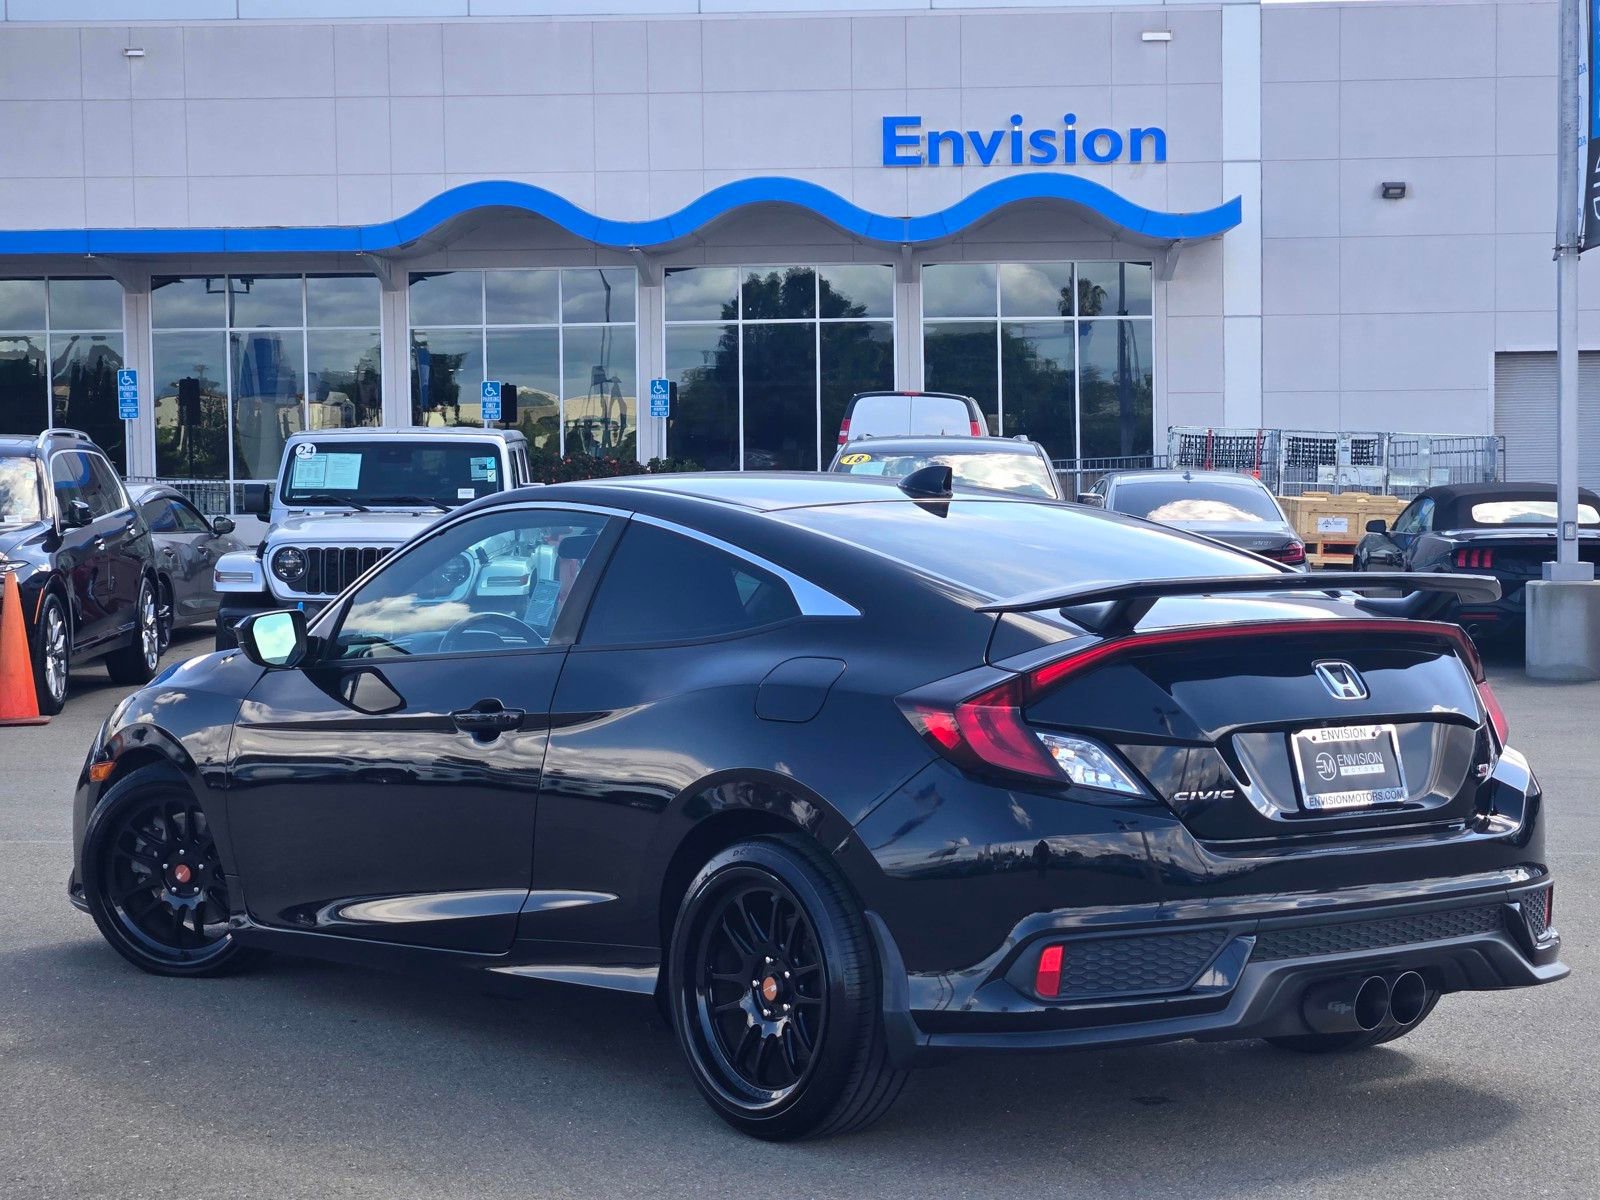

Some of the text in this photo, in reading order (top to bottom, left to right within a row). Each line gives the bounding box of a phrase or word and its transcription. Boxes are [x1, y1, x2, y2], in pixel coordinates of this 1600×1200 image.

[882, 113, 1167, 167] Envision
[298, 446, 314, 456] 24
[1320, 728, 1367, 740] ENVISION
[1337, 752, 1383, 766] ENVISION
[1173, 789, 1235, 801] CIVIC
[1309, 789, 1404, 806] ENVISIONMOTORS.COM
